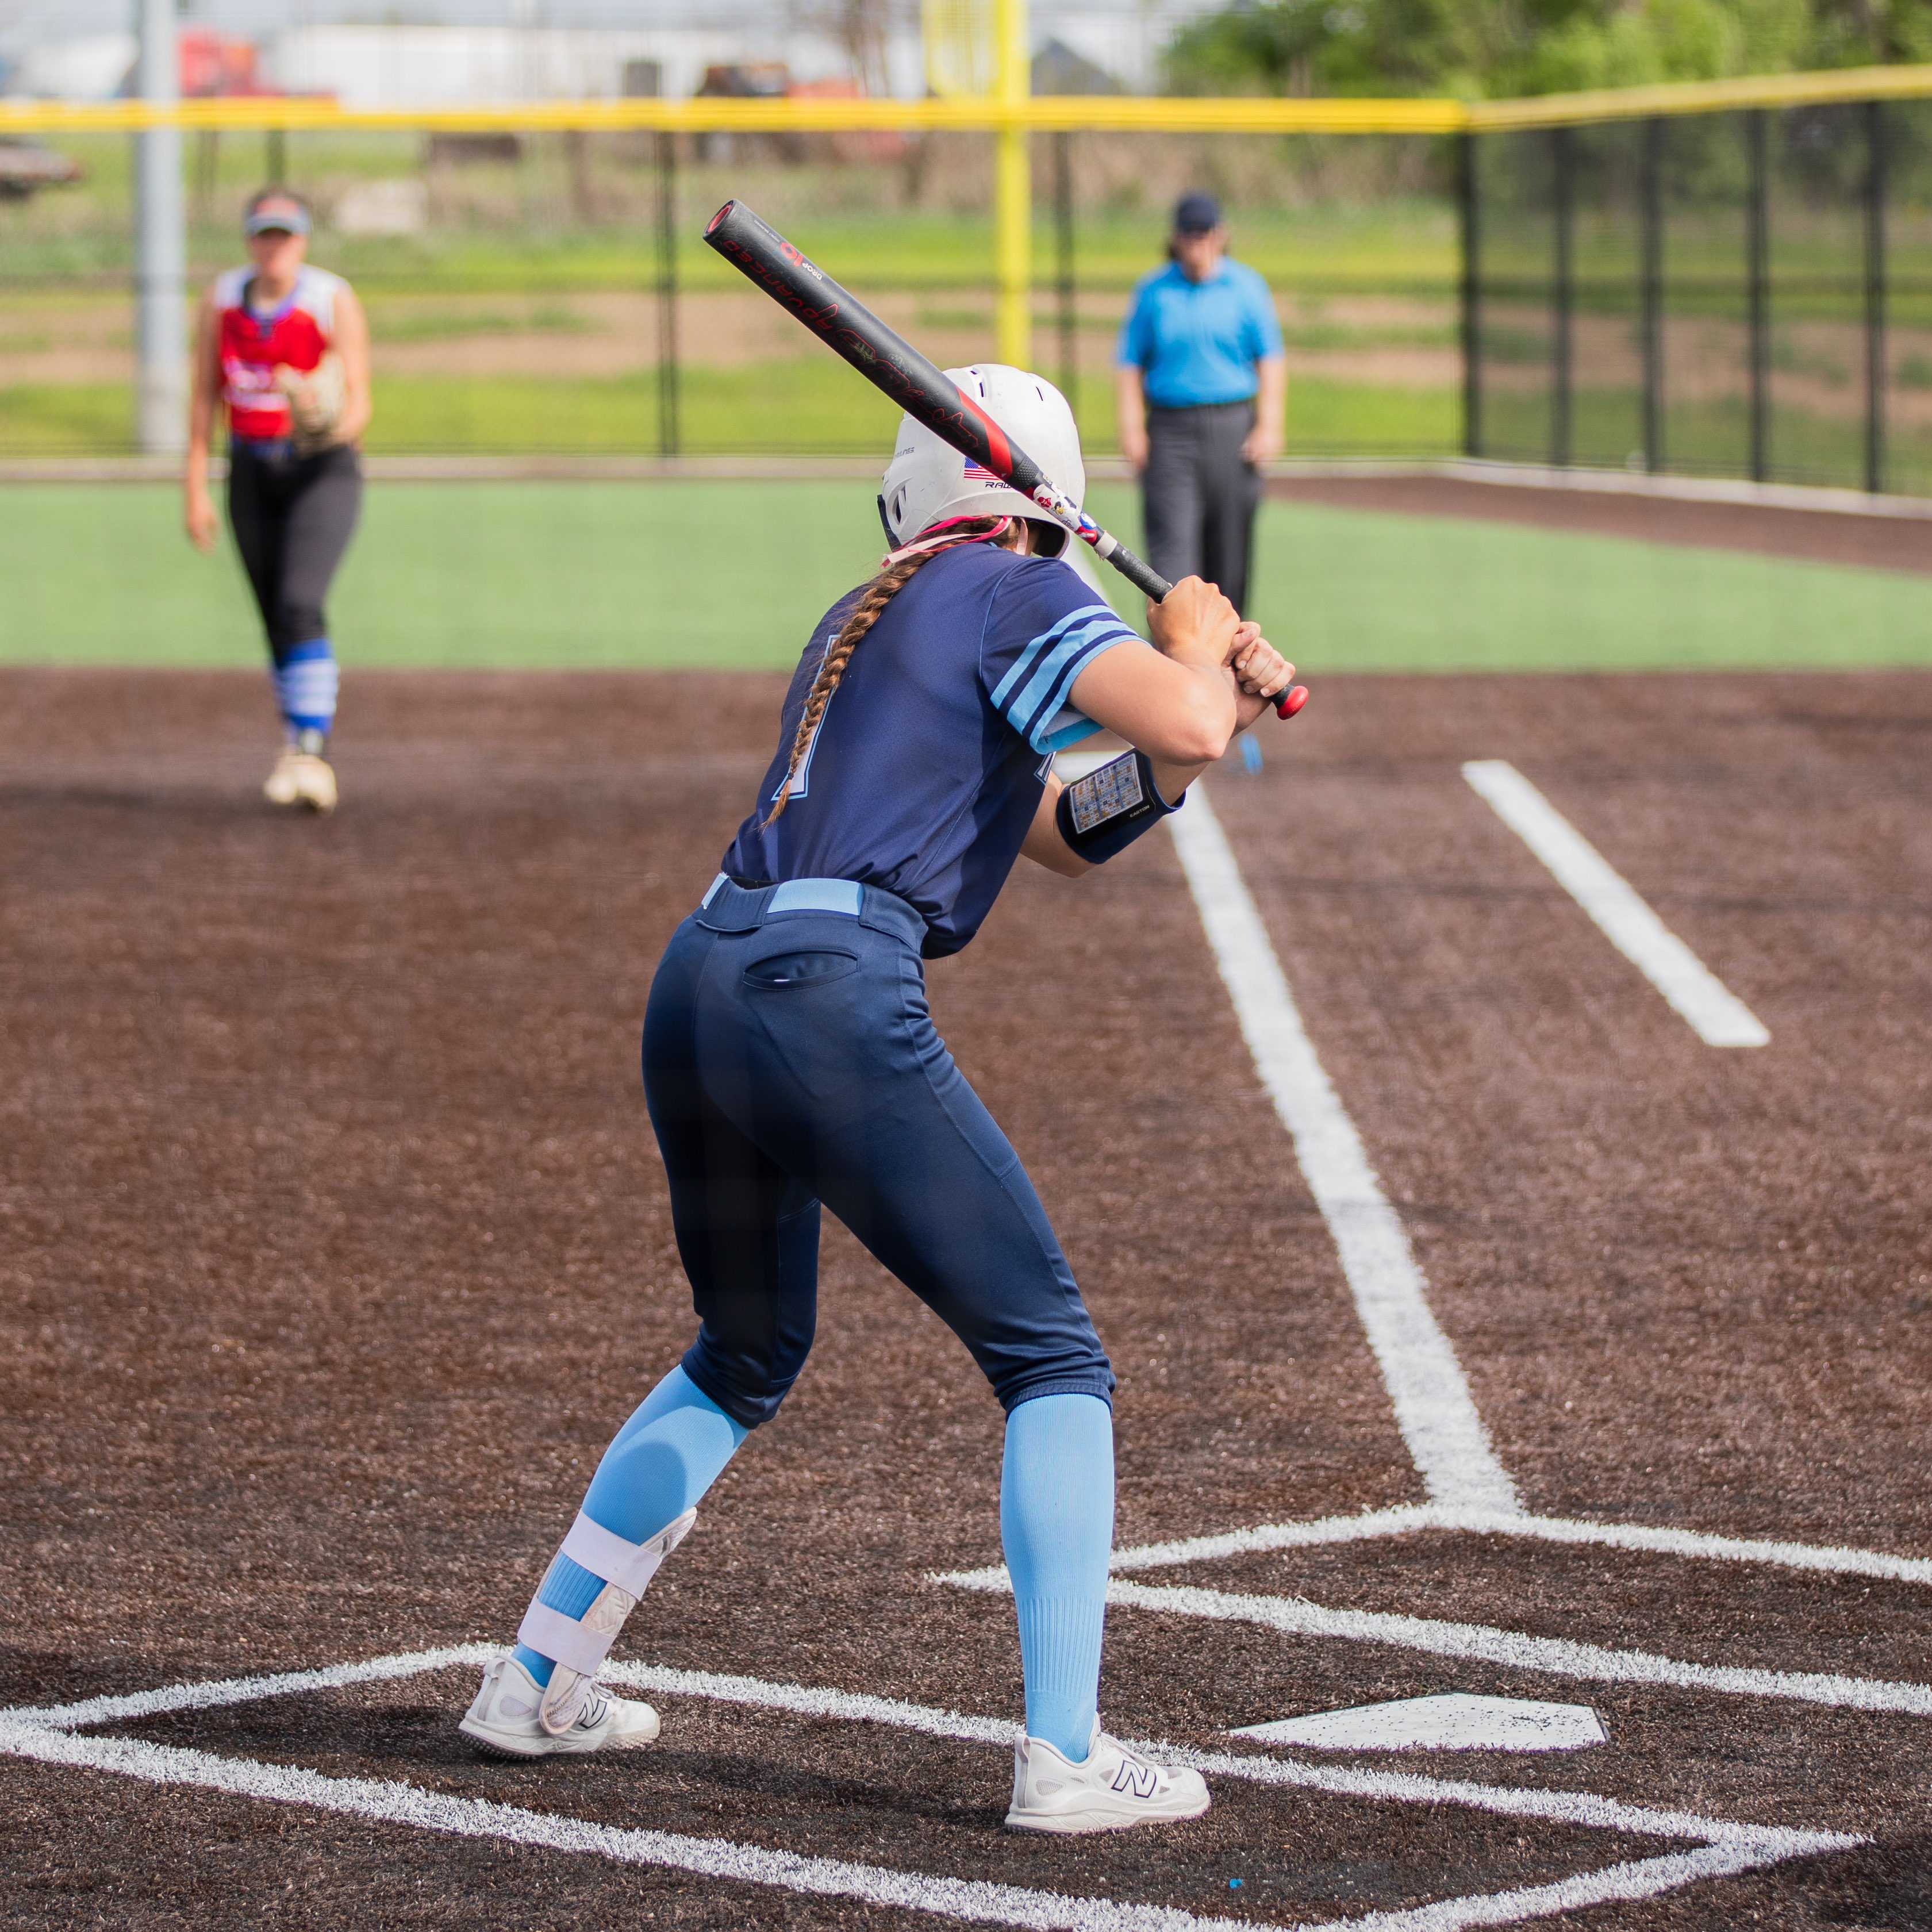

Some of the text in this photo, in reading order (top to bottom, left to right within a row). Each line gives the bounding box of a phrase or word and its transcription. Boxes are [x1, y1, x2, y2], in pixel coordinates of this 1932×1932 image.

[781, 242, 803, 267] 10
[803, 263, 823, 281] DROP
[724, 240, 832, 330] ADVANCED
[1130, 805, 1150, 817] EASTON
